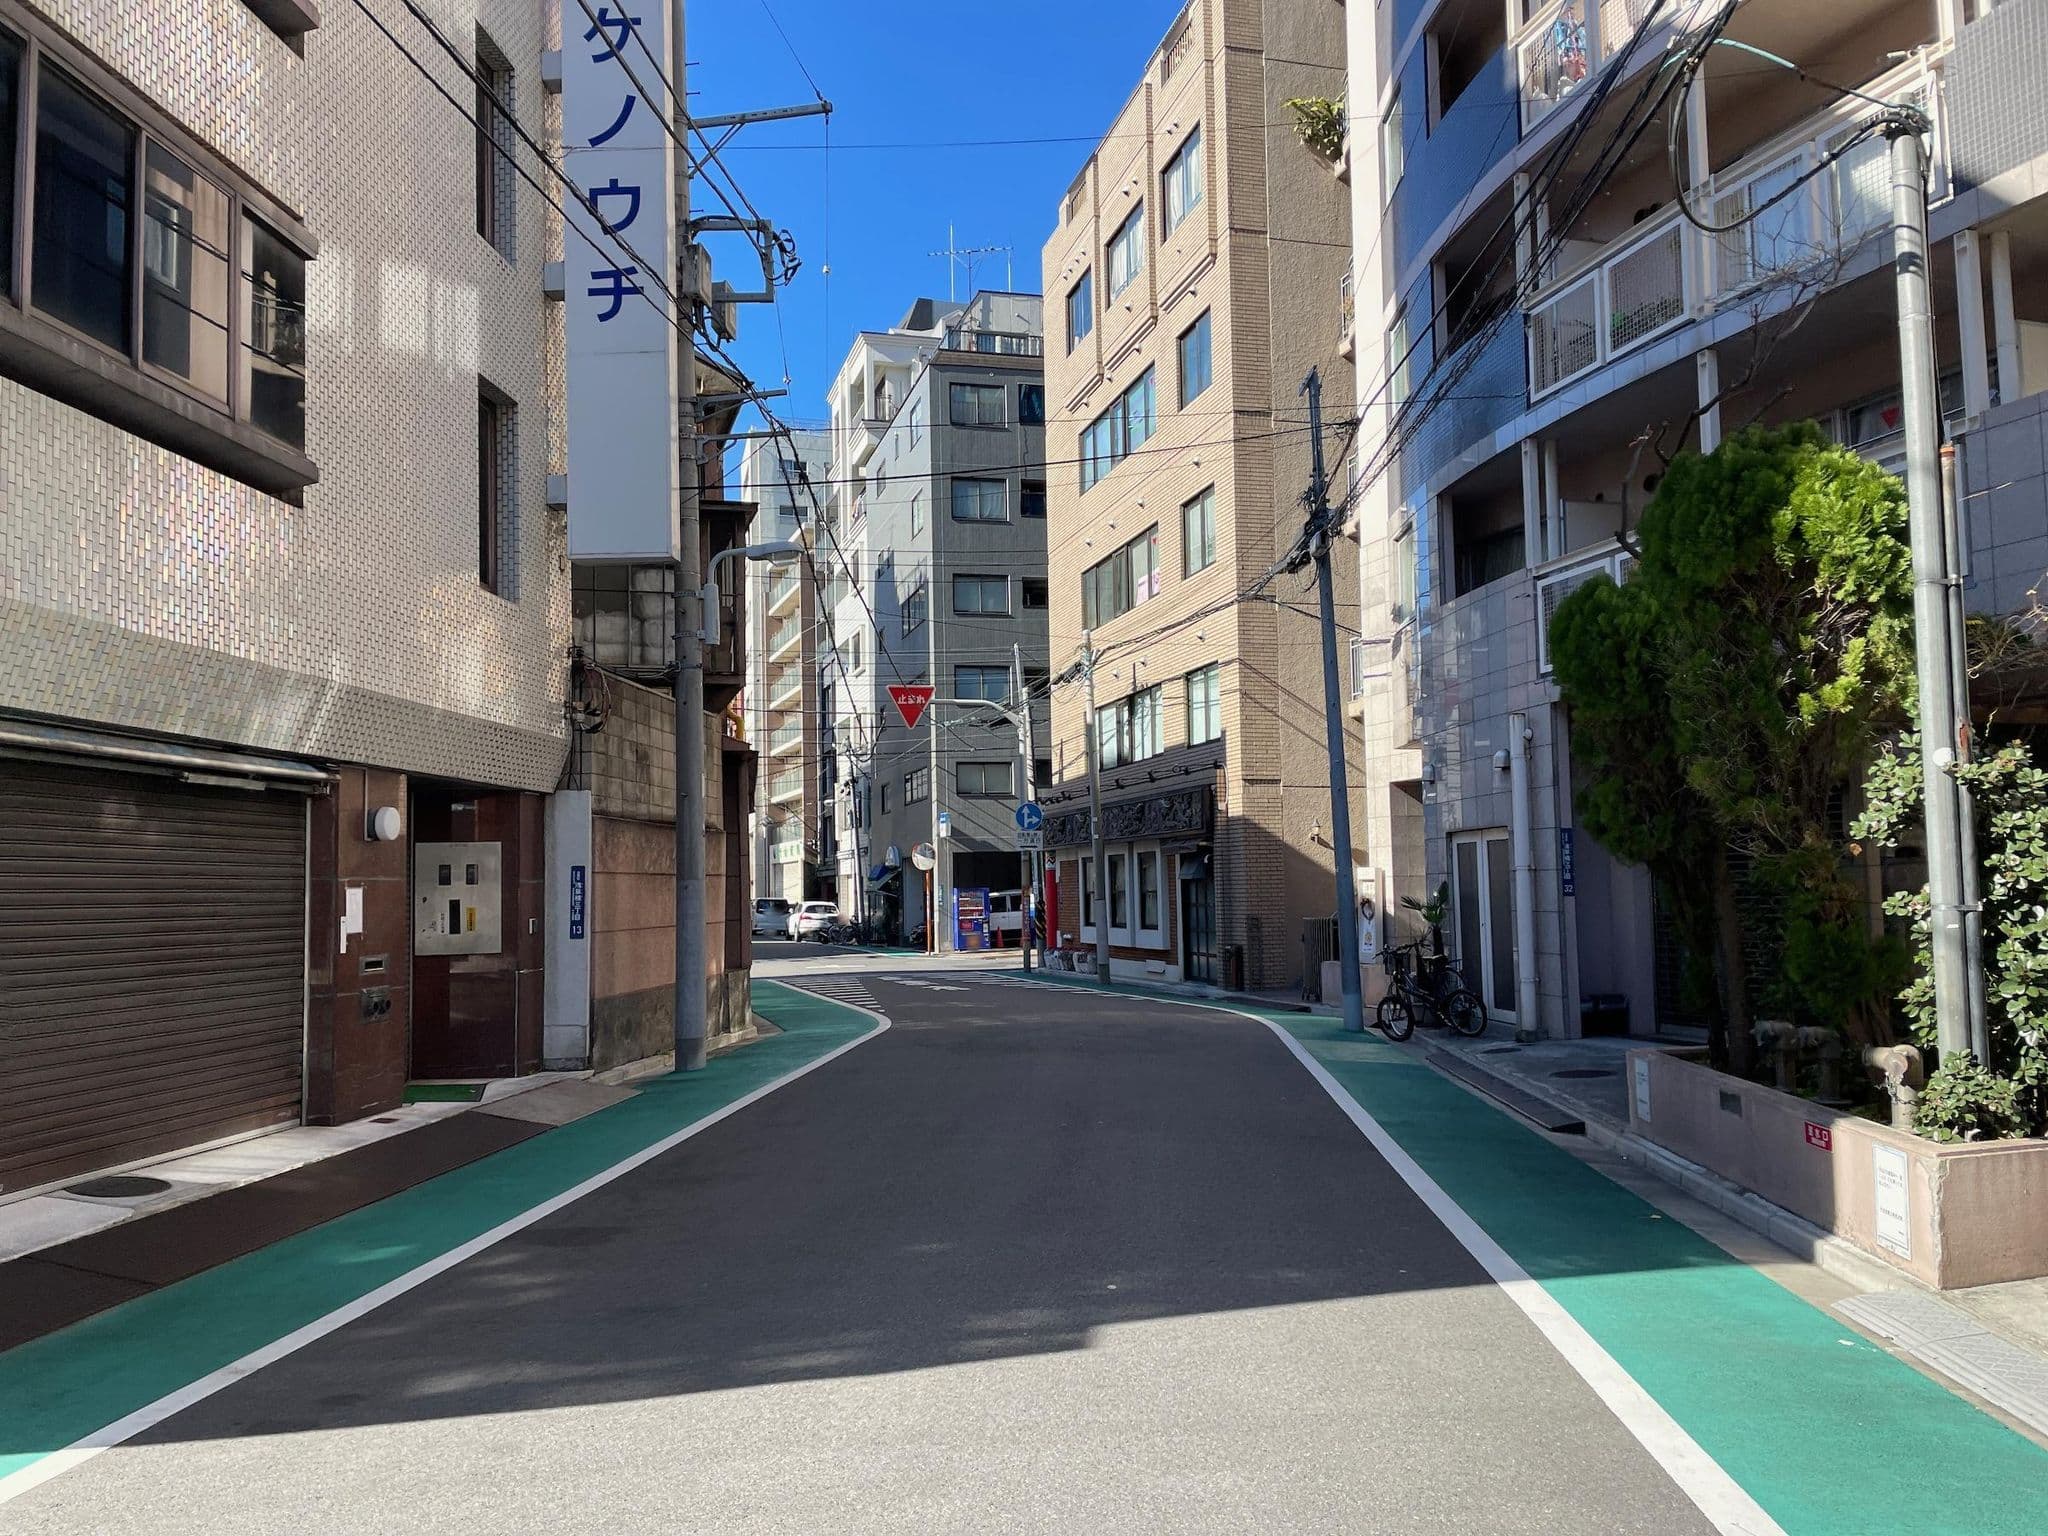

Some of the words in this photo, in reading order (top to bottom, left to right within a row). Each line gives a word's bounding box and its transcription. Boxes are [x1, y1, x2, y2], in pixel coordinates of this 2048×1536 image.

[583, 7, 645, 323] ケノウチ
[897, 694, 926, 705] 止まれ
[1564, 884, 1573, 893] 32
[572, 925, 582, 935] 13
